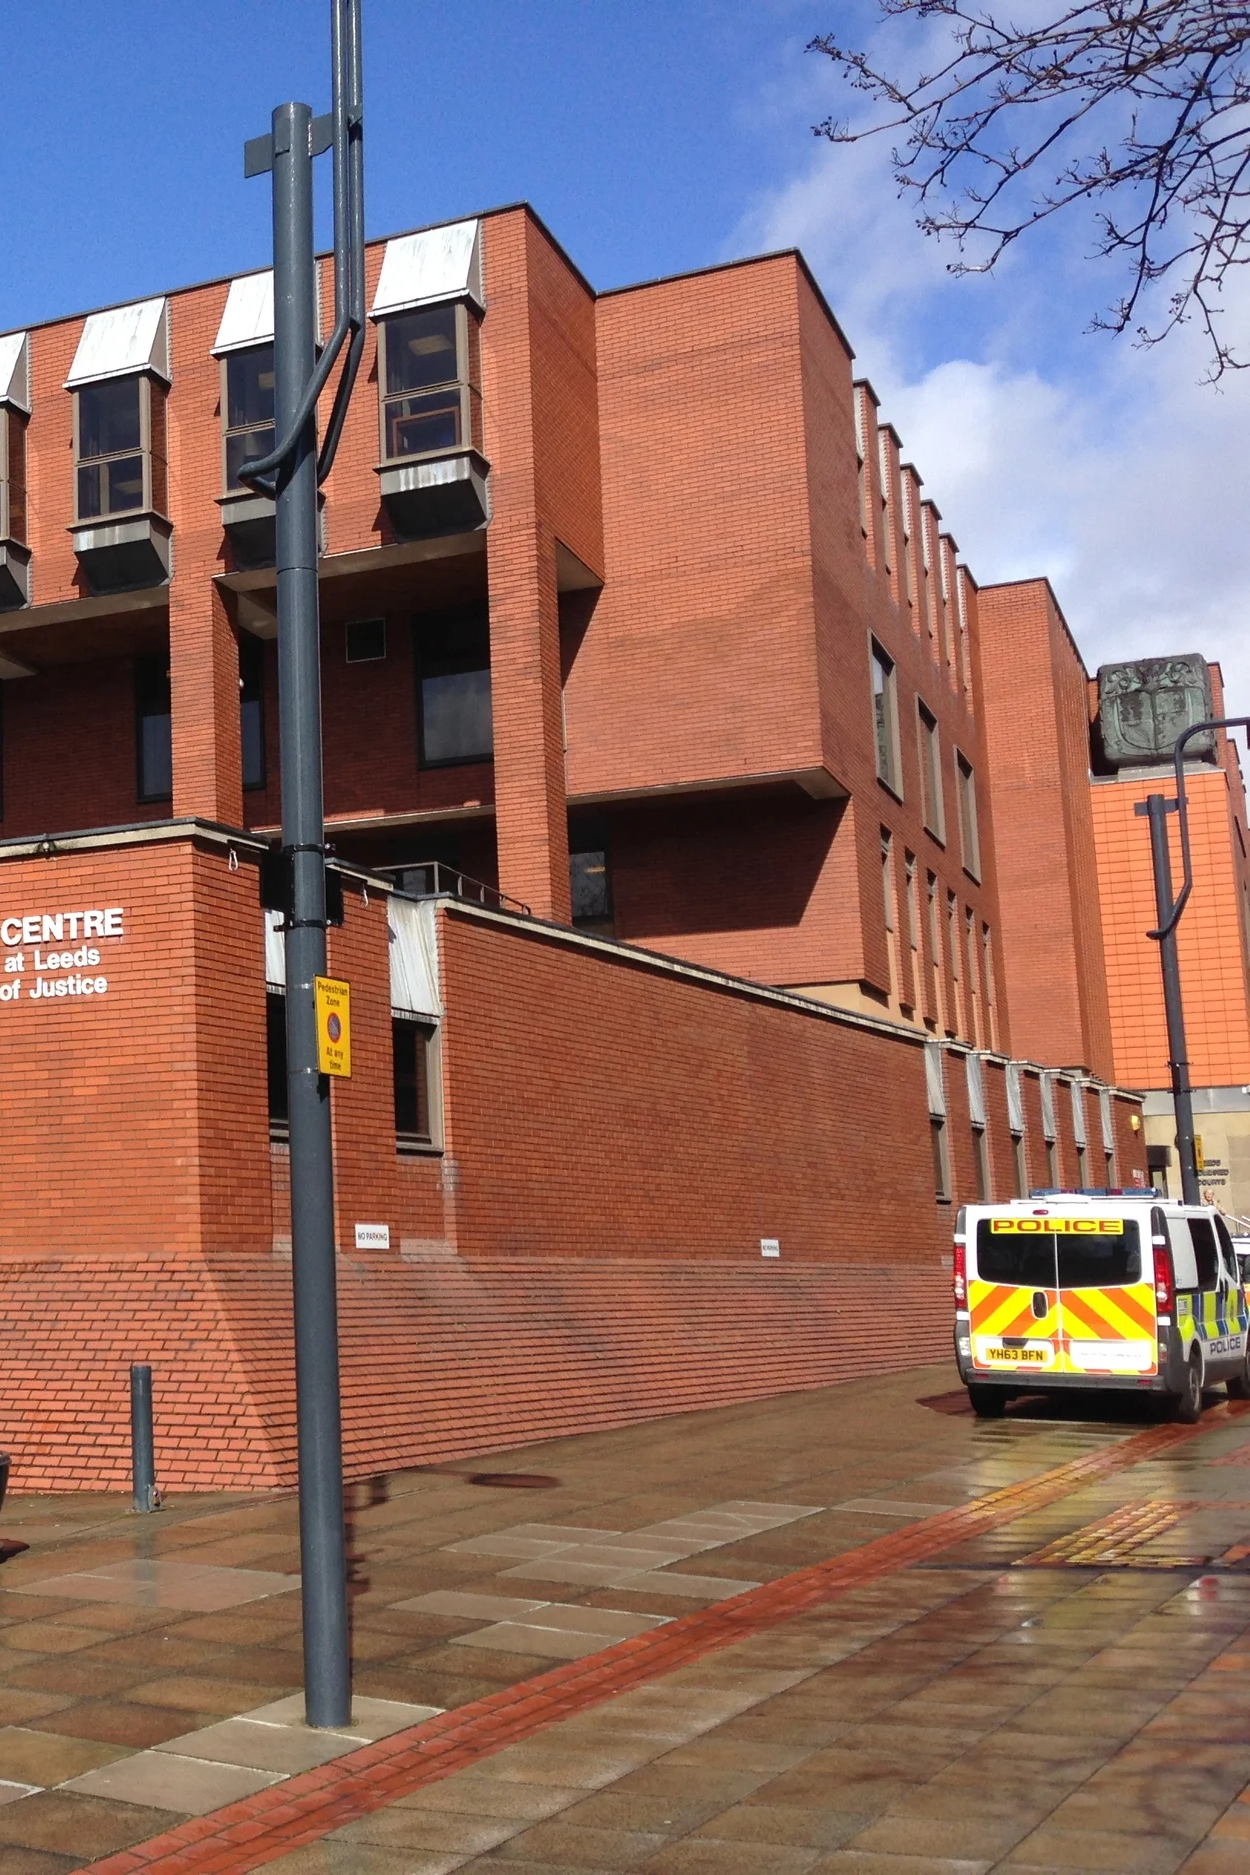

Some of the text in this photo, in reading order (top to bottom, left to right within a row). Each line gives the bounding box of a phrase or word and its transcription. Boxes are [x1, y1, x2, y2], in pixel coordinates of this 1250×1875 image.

[0, 908, 124, 946] CENTRE
[4, 952, 25, 973] at
[34, 945, 100, 971] Leeds
[0, 979, 21, 1001] of
[29, 973, 108, 999] Justice
[317, 981, 348, 997] Pedestrian
[326, 995, 340, 1007] Zone
[326, 1046, 343, 1060] At any
[329, 1060, 341, 1071] time
[993, 1219, 1121, 1233] POLICE
[358, 1232, 387, 1241] NO PARKING
[1210, 1336, 1241, 1355] POLICE
[989, 1349, 1044, 1361] YH63 BFN
